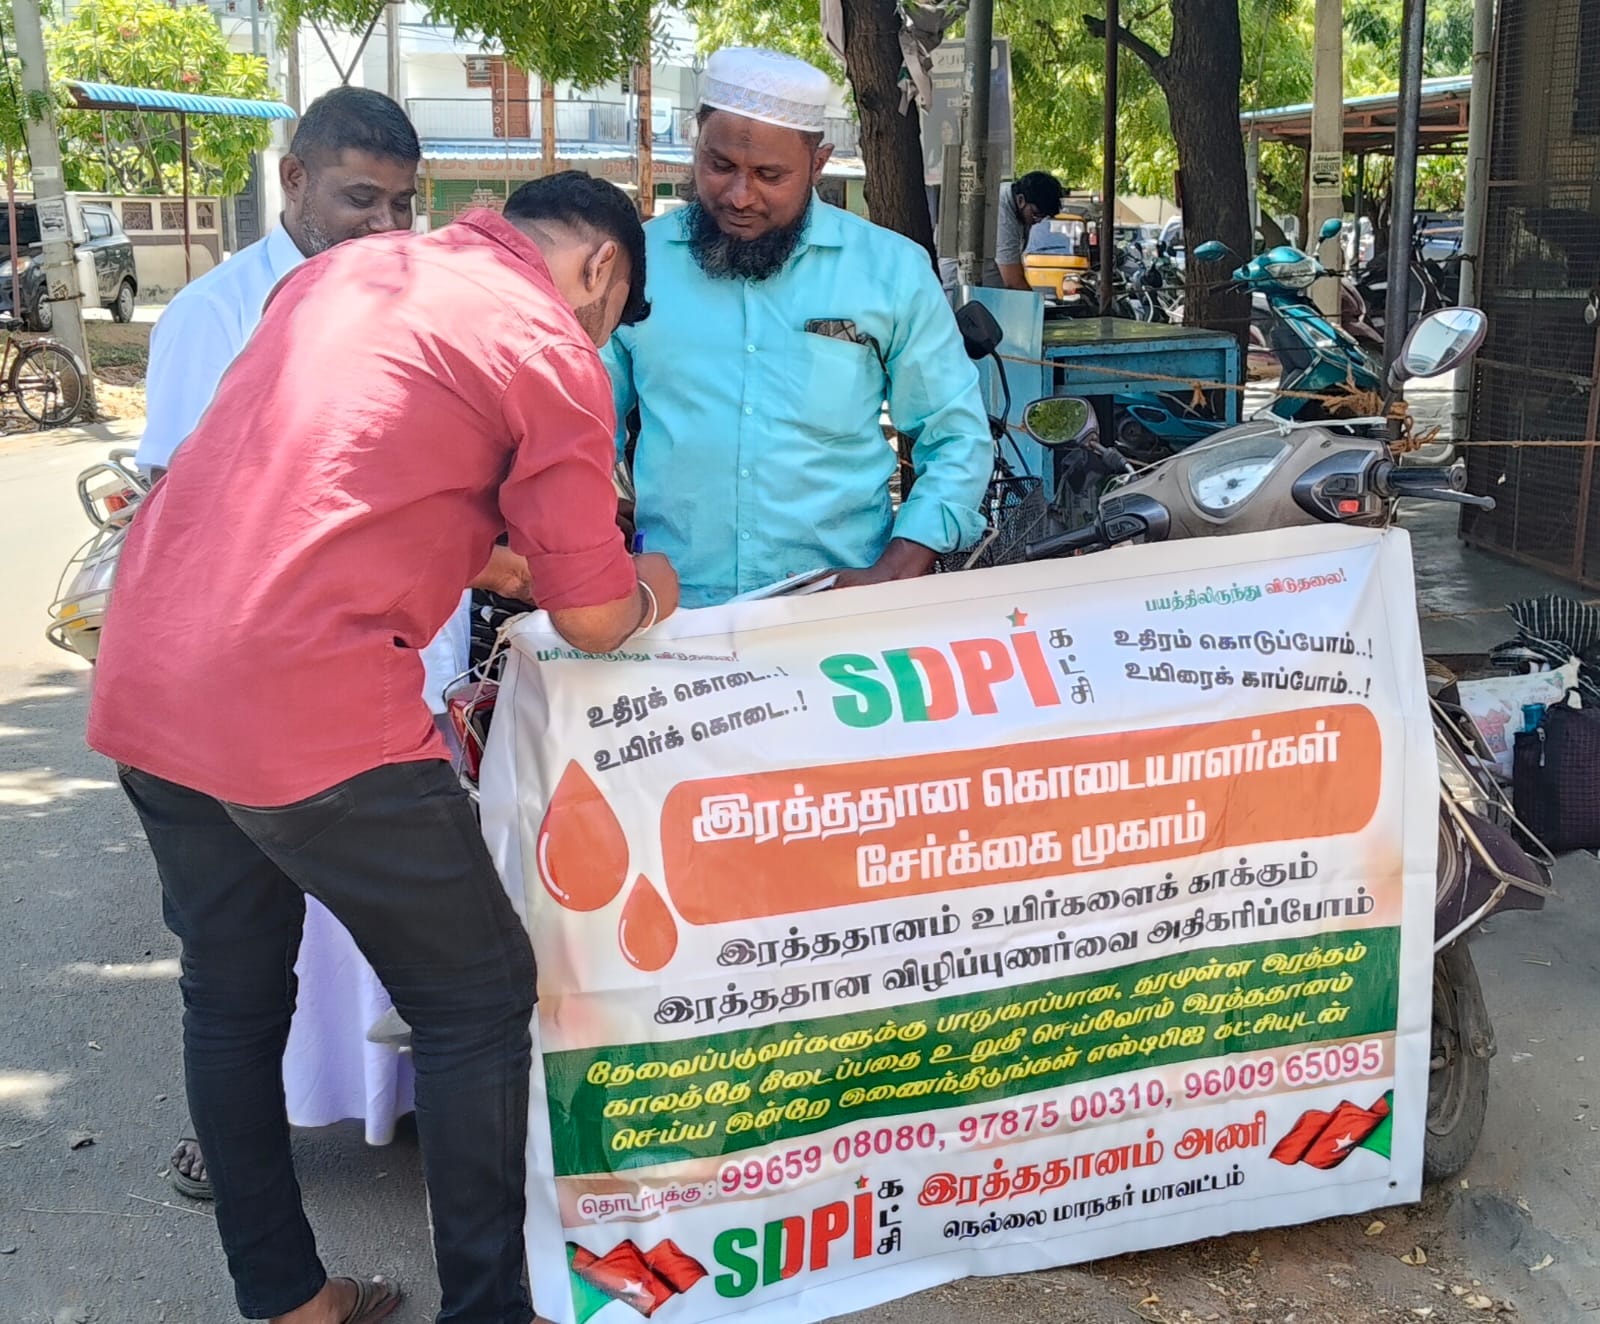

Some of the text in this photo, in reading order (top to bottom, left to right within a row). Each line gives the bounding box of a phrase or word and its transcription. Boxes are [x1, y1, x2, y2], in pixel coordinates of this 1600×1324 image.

[1145, 567, 1348, 612] பயத்திலிருந்து விடுதலை!
[1113, 628, 1193, 652] உதிரம்
[1124, 661, 1235, 691] உயிரைக்
[586, 685, 669, 729] உதிரக்
[593, 724, 685, 773] உயிர்க்
[692, 719, 1341, 846] இரத்ததான கொடையாளர்கள்
[856, 798, 1207, 889] சேர்க்கை முகாம்
[716, 850, 1319, 967] இரத்ததானம் உயிர்களைக் காக்கும்
[653, 886, 1375, 1025] இரத்ததான விழிப்புணர்வை அதிகரிப்போம்
[1129, 956, 1255, 1000] தரமுள்ள
[1260, 939, 1368, 977] இரத்தம்
[602, 1082, 753, 1119] காலத்தே
[1030, 996, 1176, 1045] செய்வோம்
[1181, 970, 1355, 1016] இரத்ததானம்
[610, 1118, 717, 1153] செய்ய
[725, 1096, 831, 1136] இன்றே
[720, 1144, 823, 1195] 99659
[832, 1121, 947, 1165] 08080,
[958, 1099, 1060, 1144] 97875
[1069, 1077, 1174, 1124] 00310,
[1184, 1060, 1276, 1100] 96009
[1285, 1042, 1382, 1083] 65095
[917, 1110, 1267, 1207] இரத்ததானம் அணி
[943, 1164, 1246, 1241] நெல்லை மாநகர் மாவட்டம்
